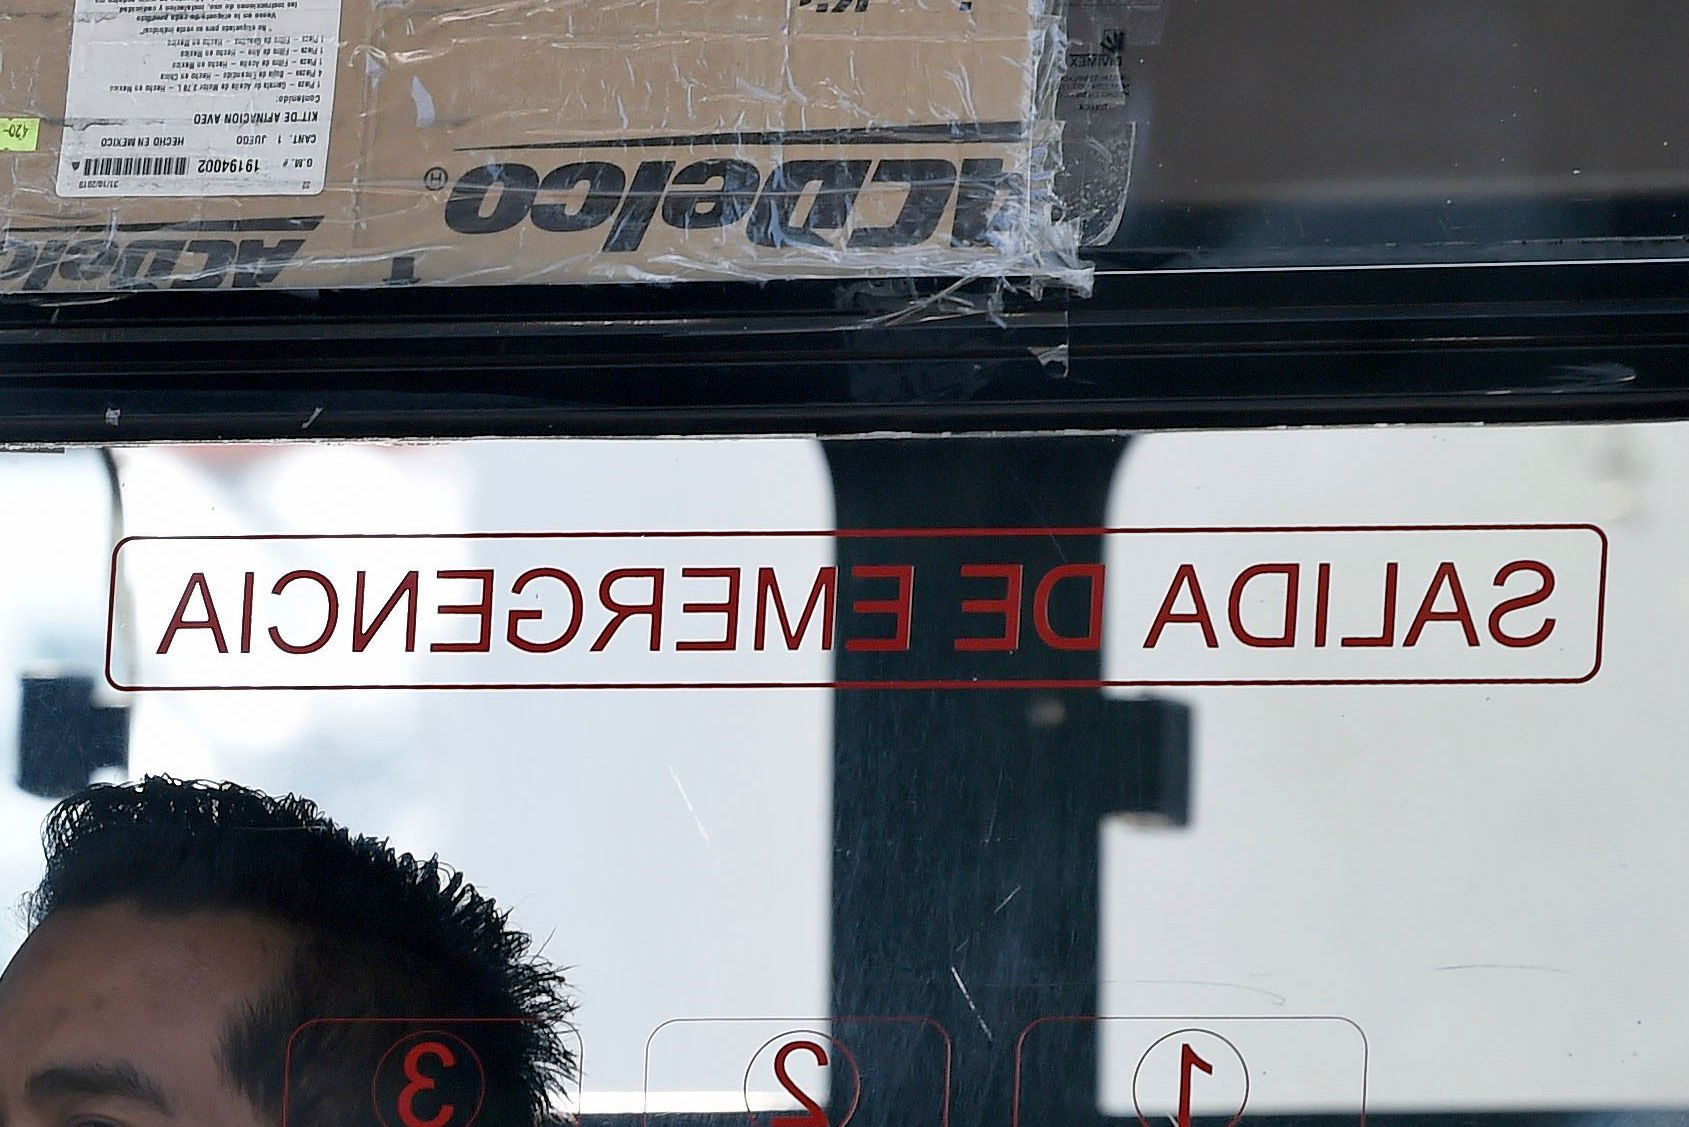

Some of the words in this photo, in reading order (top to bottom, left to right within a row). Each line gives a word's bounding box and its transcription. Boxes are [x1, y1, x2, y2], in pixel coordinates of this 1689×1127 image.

[193, 113, 221, 125] AVEO
[224, 112, 281, 124] AFINACION
[284, 112, 297, 122] DE
[299, 111, 318, 122] KIT
[101, 138, 136, 147] MEXICO
[138, 137, 150, 146] EN
[153, 137, 184, 146] HECHO
[236, 135, 267, 145] JUEGO
[197, 159, 260, 173] 19194002
[444, 157, 1021, 253] ACDelco
